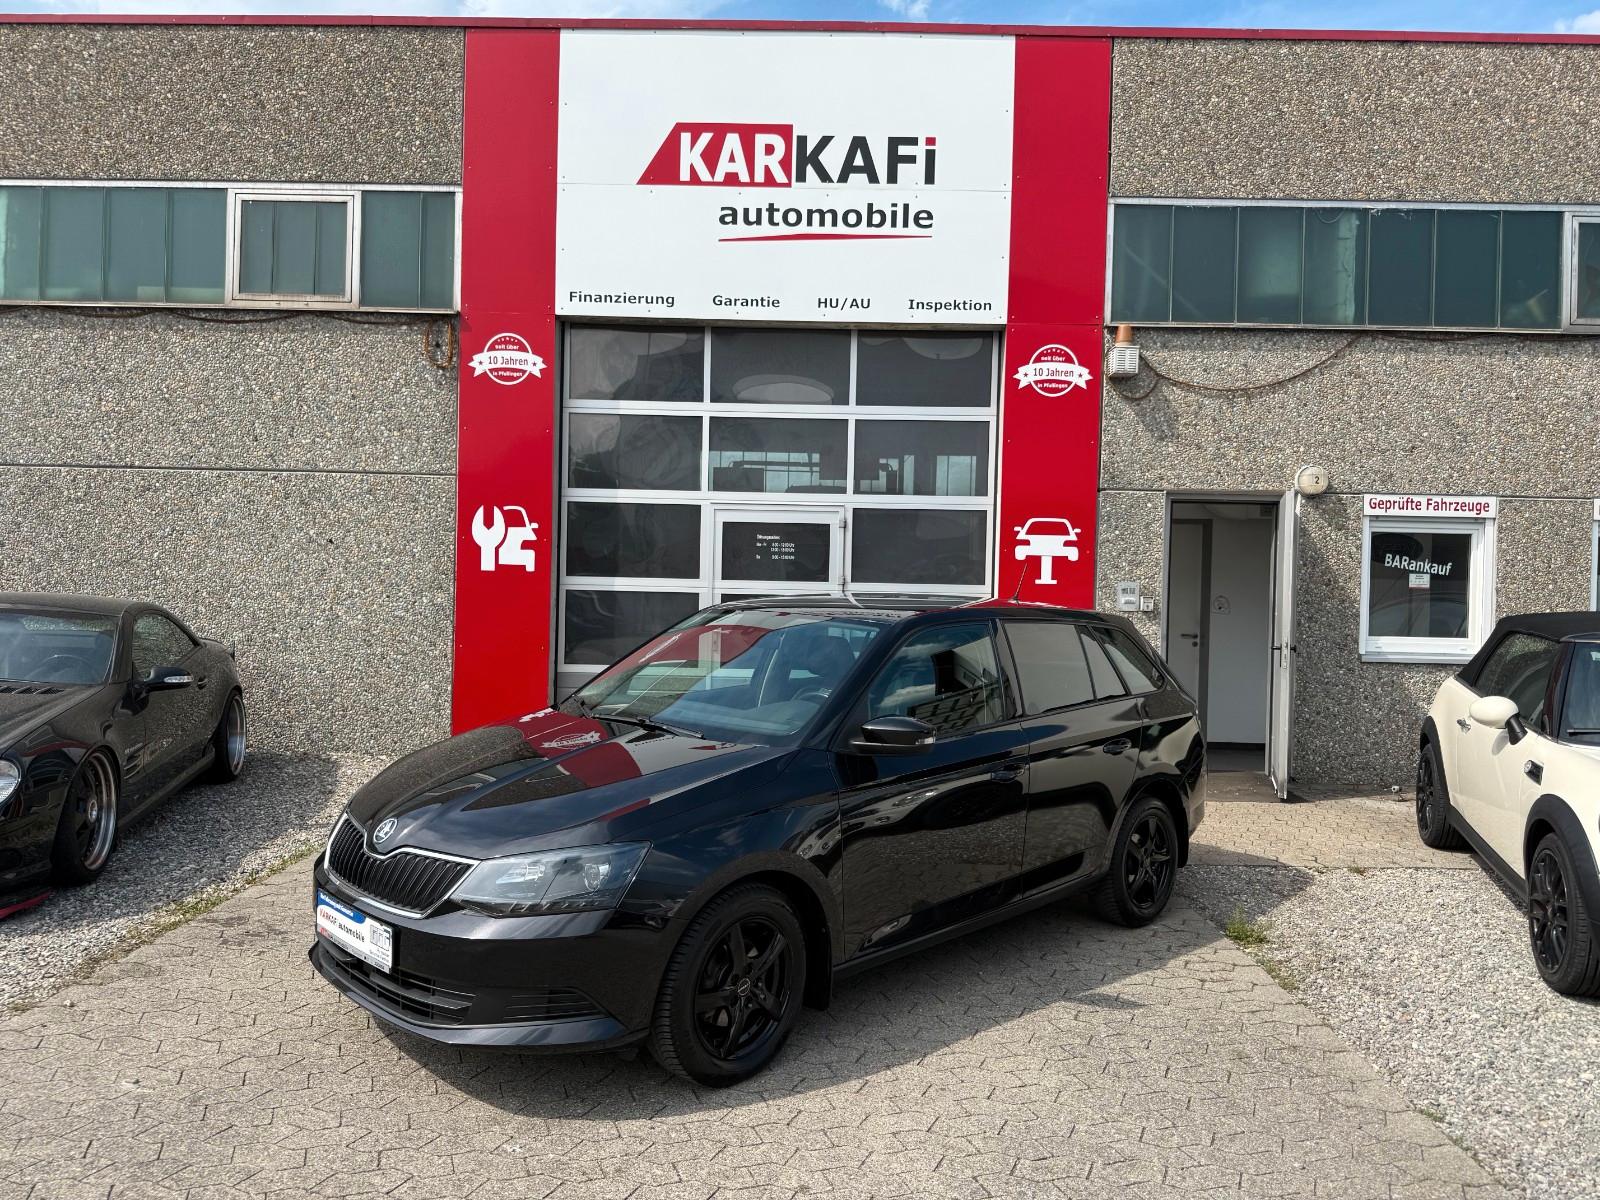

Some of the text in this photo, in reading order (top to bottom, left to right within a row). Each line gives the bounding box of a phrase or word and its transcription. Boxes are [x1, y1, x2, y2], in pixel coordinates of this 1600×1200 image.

[718, 202, 934, 229] automobile
[569, 291, 675, 308] Finanzierung
[712, 294, 780, 308] Garantie
[817, 296, 871, 311] HU/AU
[908, 298, 992, 314] Inspektion
[488, 356, 528, 366] 10 Jahren
[1033, 368, 1074, 377] 10 Jahren
[1314, 476, 1320, 485] 2
[1369, 497, 1490, 515] Geprüfte Fahrzeuge
[1384, 553, 1452, 576] BARankauf
